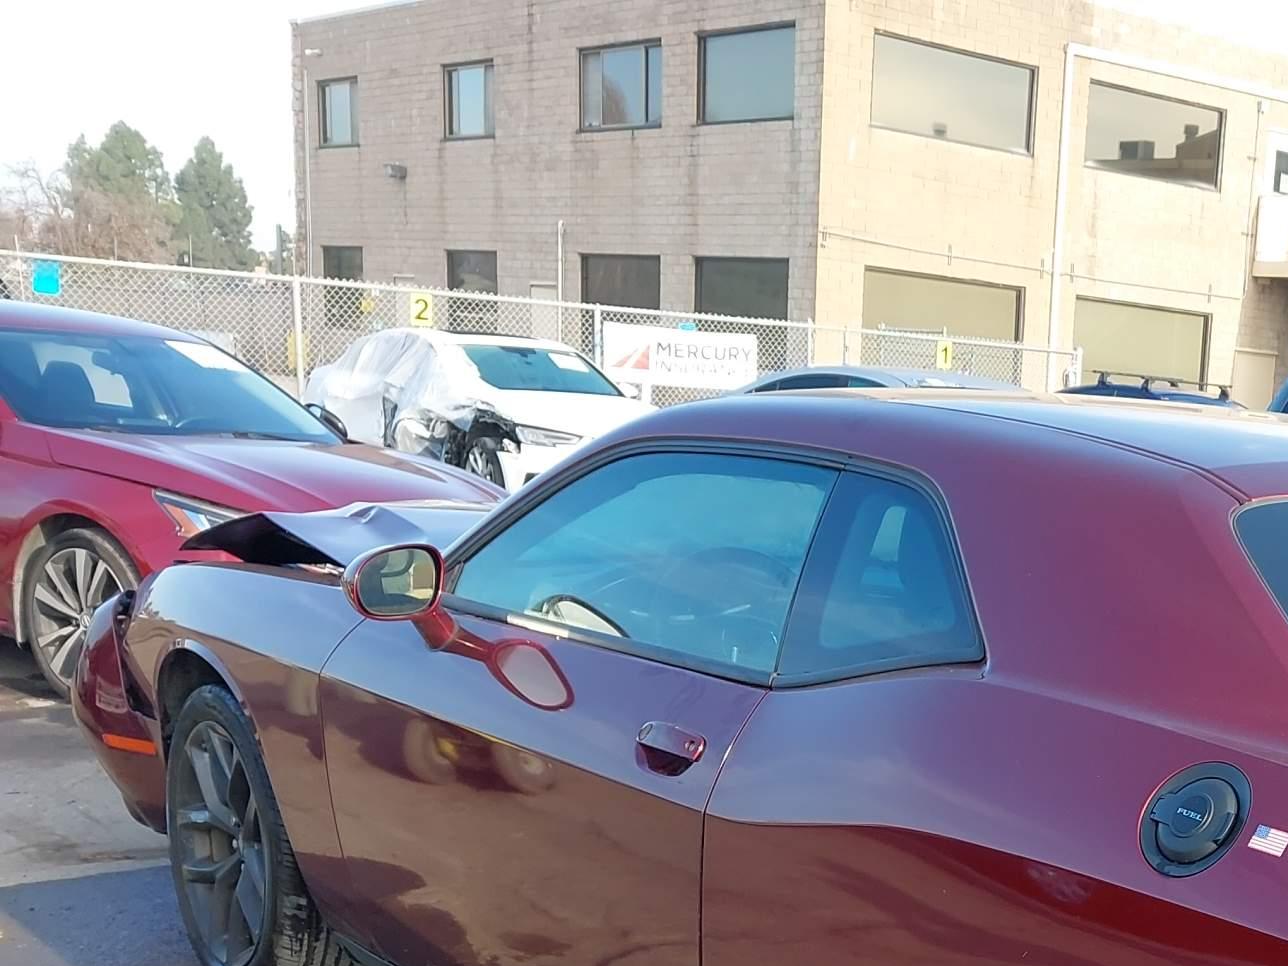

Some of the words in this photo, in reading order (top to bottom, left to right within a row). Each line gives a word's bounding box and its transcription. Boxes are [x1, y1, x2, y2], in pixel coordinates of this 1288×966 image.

[415, 298, 429, 320] 2
[656, 342, 752, 361] MERCURY
[941, 345, 948, 364] 1
[1176, 807, 1203, 822] FUEL
